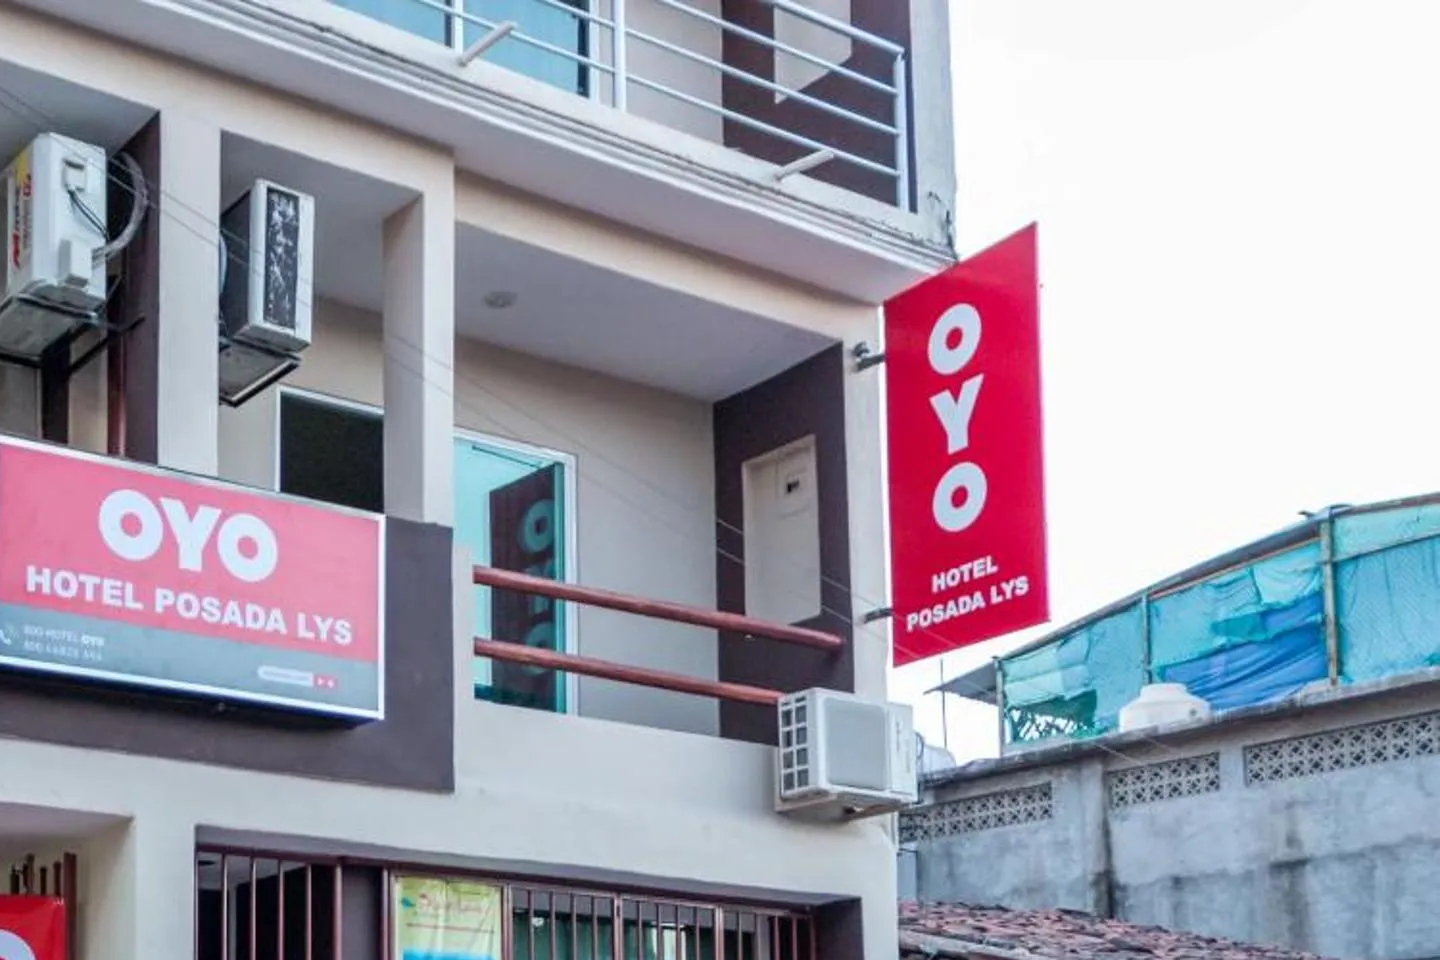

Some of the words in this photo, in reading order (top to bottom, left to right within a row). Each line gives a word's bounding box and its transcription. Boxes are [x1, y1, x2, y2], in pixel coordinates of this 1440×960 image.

[927, 302, 988, 532] OYO
[98, 488, 279, 583] OYO
[931, 554, 999, 593] HOTEL
[25, 565, 145, 610] HOTEL
[154, 587, 287, 635] POSADA
[296, 613, 353, 646] LYS
[905, 595, 986, 633] POSADA
[990, 576, 1030, 605] LYS
